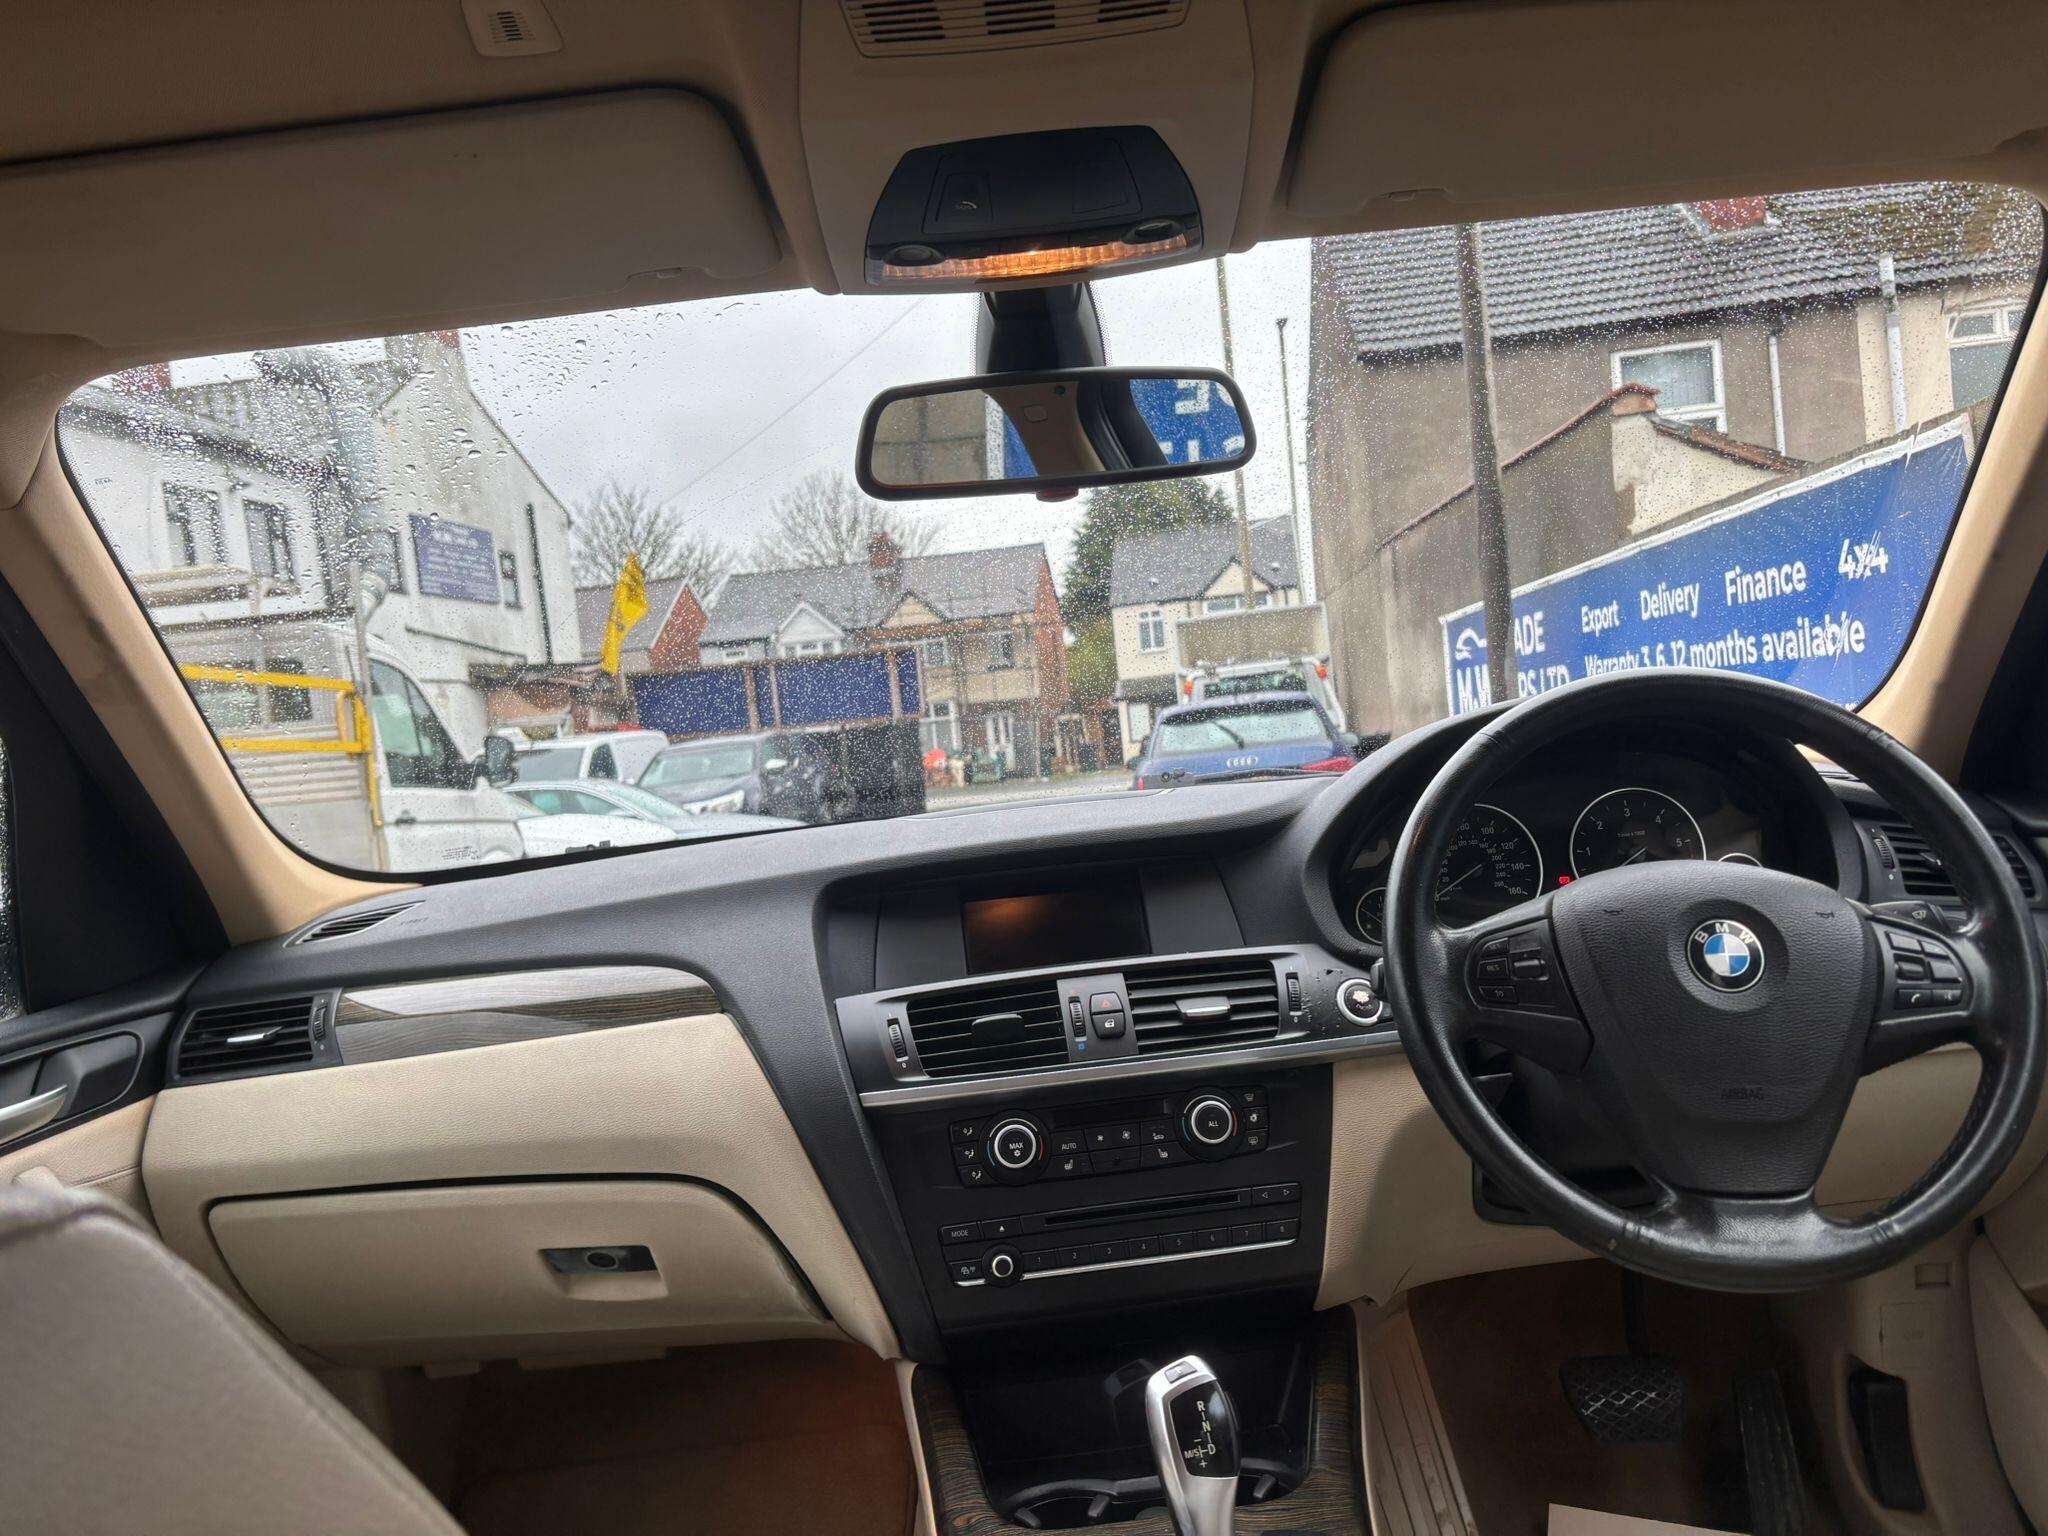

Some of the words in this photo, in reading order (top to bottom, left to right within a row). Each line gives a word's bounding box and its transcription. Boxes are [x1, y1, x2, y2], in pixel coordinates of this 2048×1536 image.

[1581, 600, 1620, 637] Export
[1640, 582, 1700, 621] Delivery
[1724, 560, 1807, 607] Finance
[1513, 611, 1546, 656] ADE
[1689, 628, 1758, 669] months
[1761, 611, 1865, 662] available
[1597, 821, 1604, 830] 2
[1624, 808, 1631, 817] 3
[1655, 815, 1662, 824] 4
[1676, 838, 1683, 847] 5
[1508, 886, 1522, 895] 160
[1695, 922, 1754, 944] BMW
[1009, 1141, 1024, 1150] MAX
[1061, 1142, 1077, 1150] AUTO
[951, 1229, 969, 1238] MODE
[1197, 1400, 1206, 1412] R
[1202, 1420, 1211, 1432] N
[1207, 1444, 1216, 1455] D
